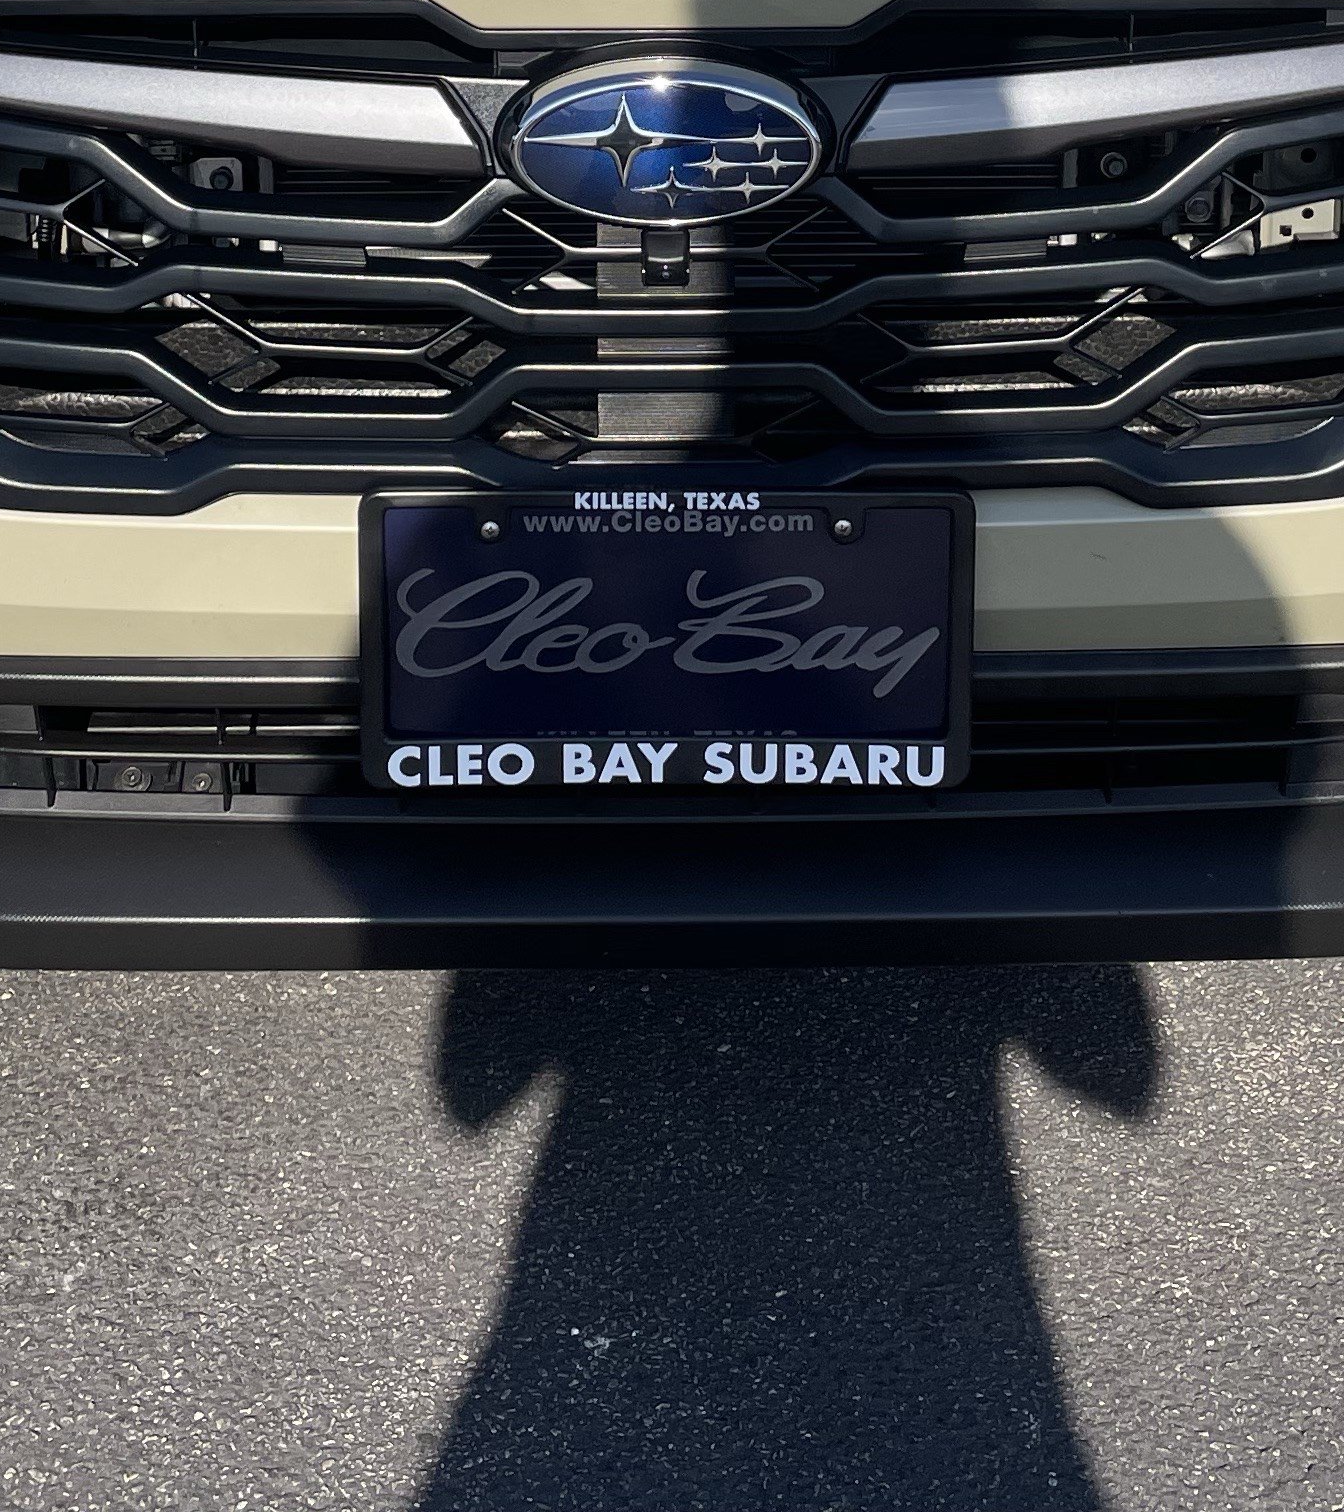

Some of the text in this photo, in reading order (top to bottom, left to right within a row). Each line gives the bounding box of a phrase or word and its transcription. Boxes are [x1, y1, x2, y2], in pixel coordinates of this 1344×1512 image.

[574, 492, 760, 512] KILLEEN, TEXAS
[523, 511, 814, 537] www.CleoBay.com
[395, 569, 941, 699] Cleo Bay
[387, 742, 946, 787] CLEO BAY SUBARU
